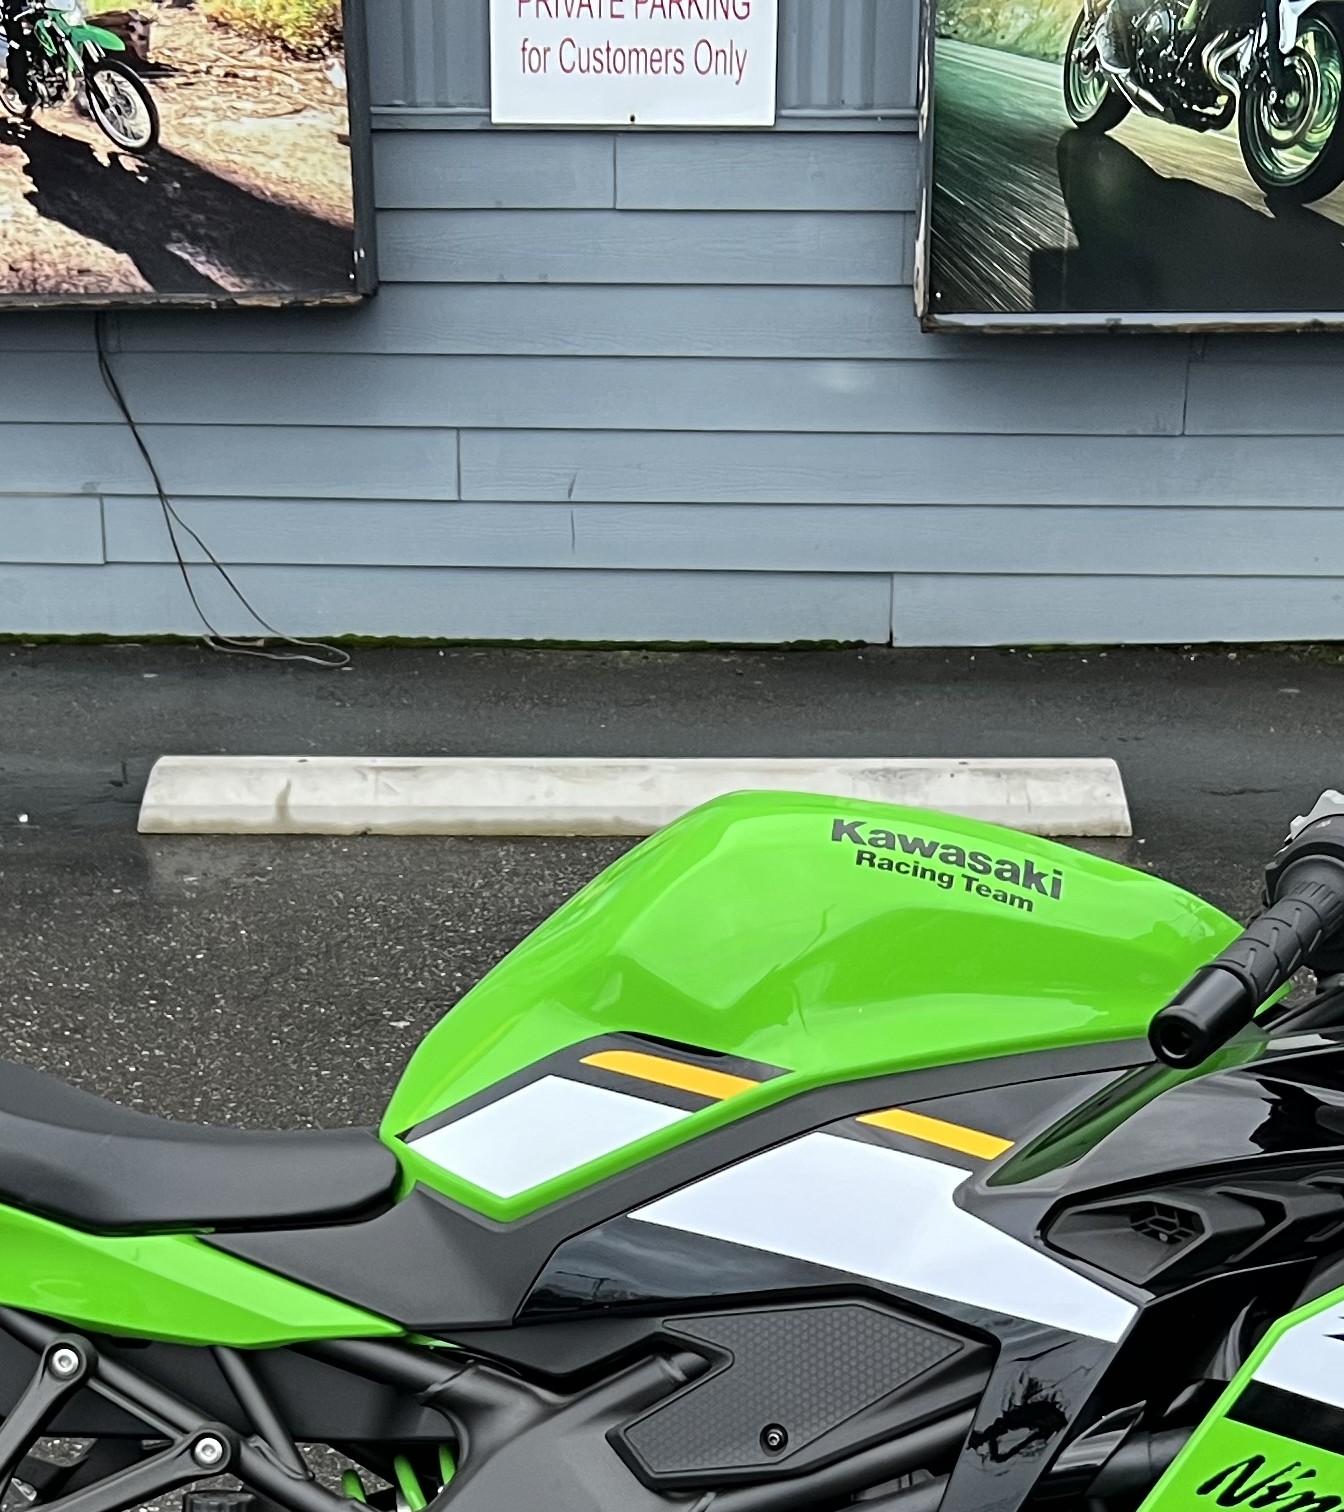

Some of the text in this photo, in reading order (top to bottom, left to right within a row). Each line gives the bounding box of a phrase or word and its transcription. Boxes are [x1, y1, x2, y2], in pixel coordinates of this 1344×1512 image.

[521, 37, 748, 85] for Customers Only
[831, 818, 1064, 900] Kawasaki
[856, 850, 1034, 912] Racing Team
